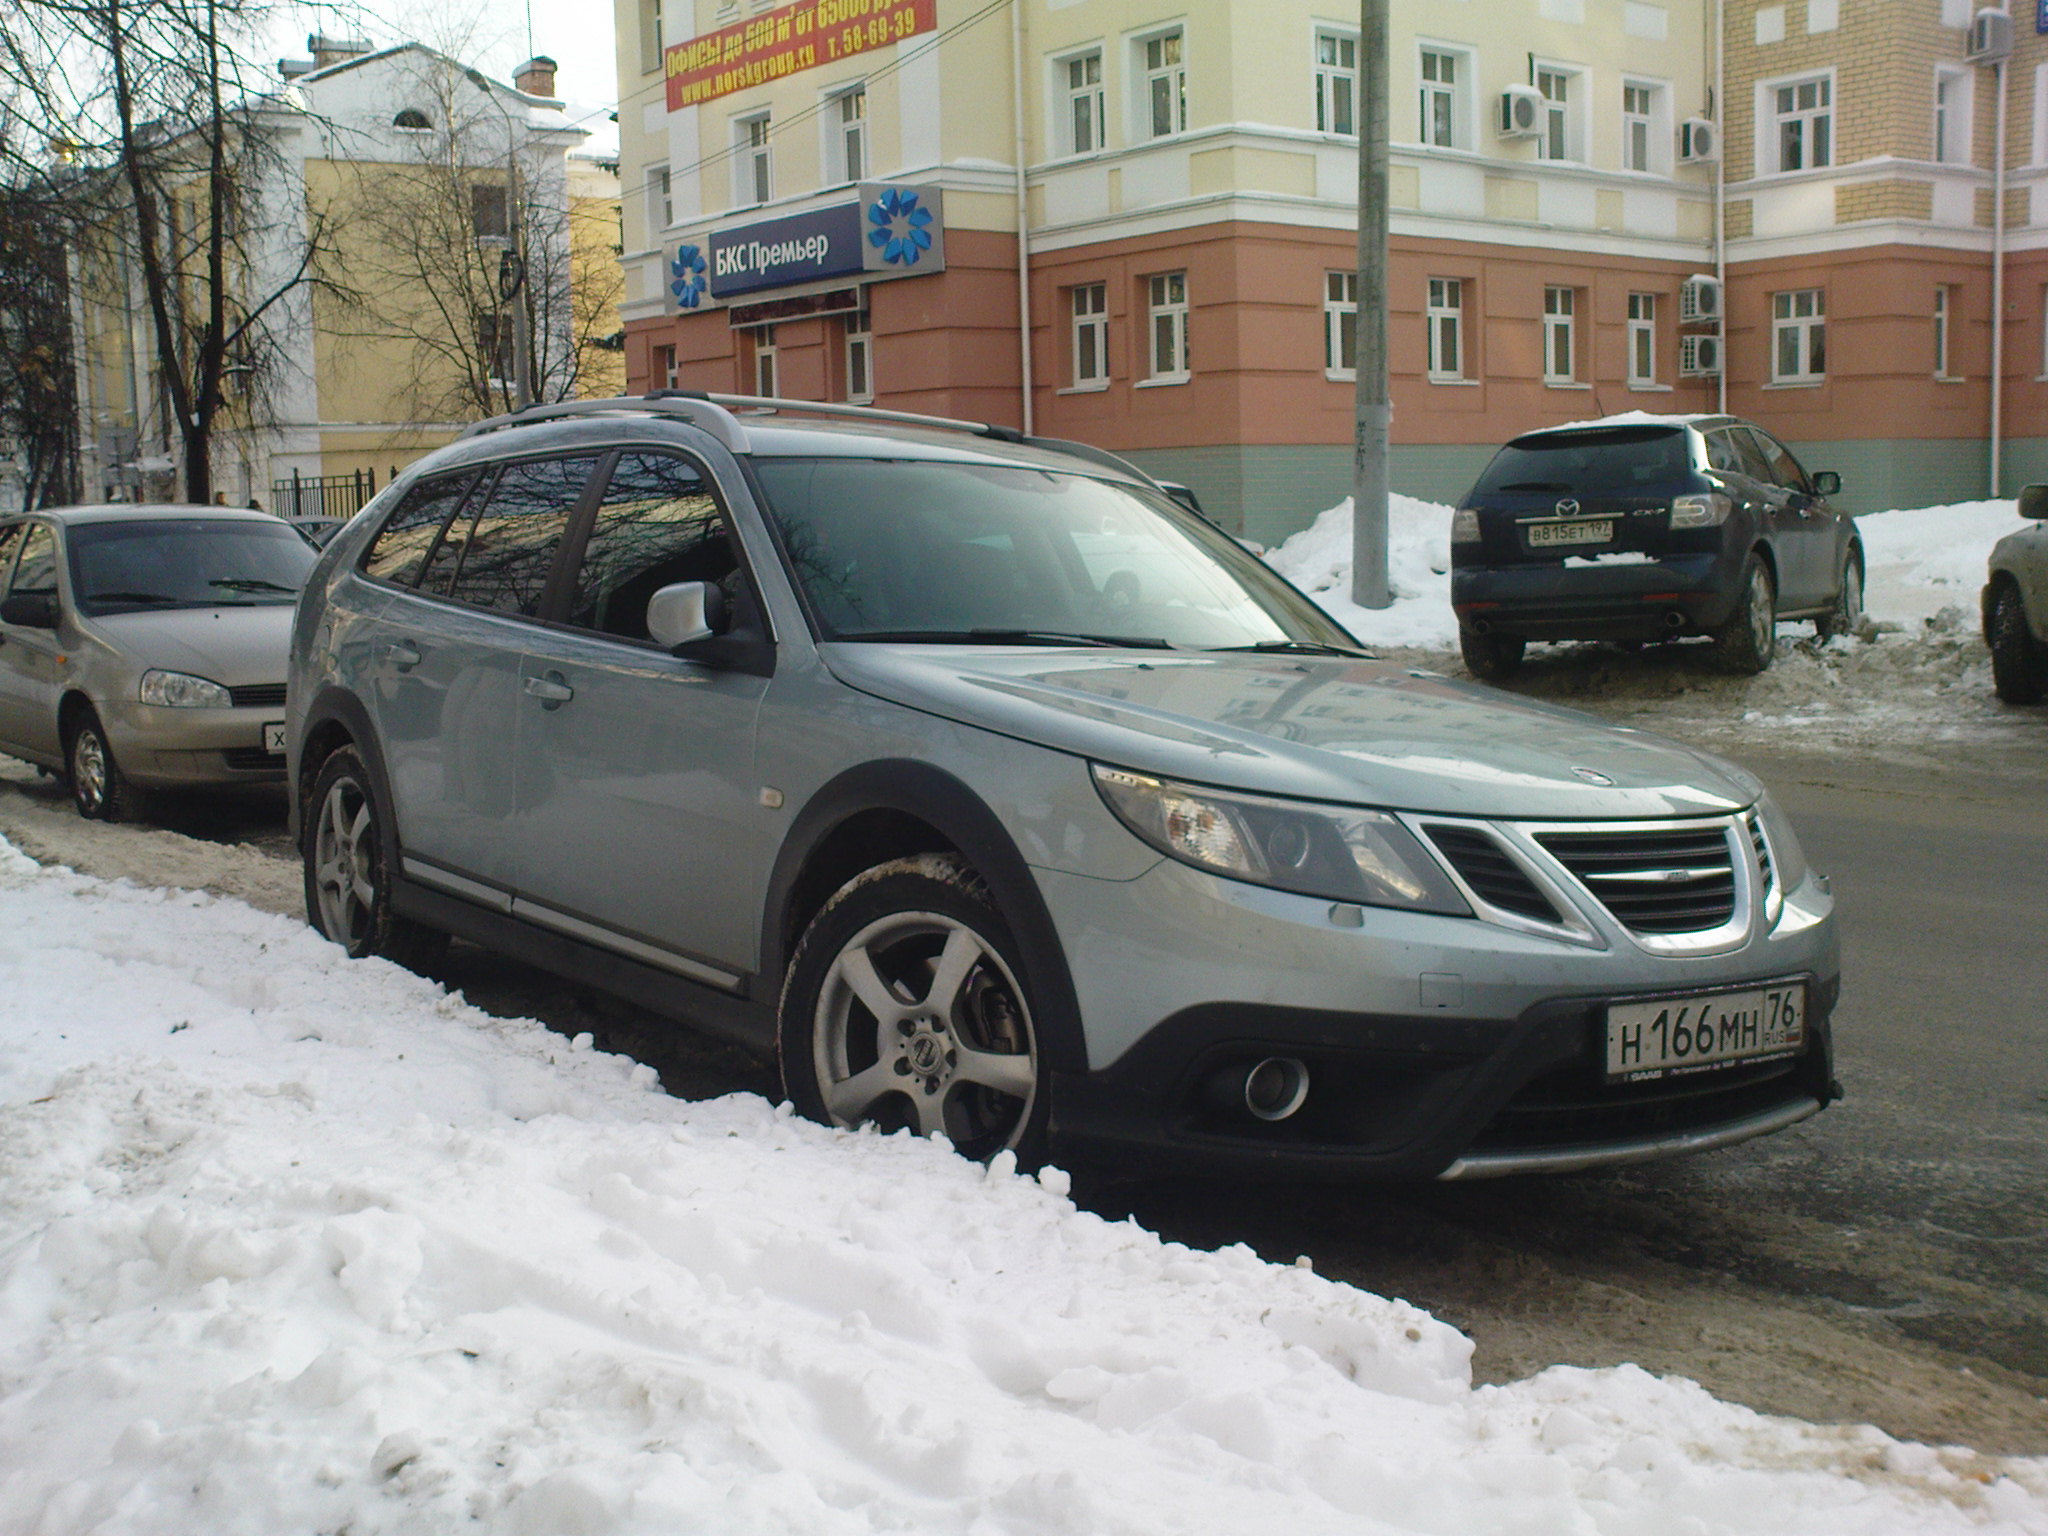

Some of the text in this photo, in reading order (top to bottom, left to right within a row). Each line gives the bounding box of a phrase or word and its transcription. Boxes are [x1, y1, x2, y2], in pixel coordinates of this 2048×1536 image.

[666, 35, 721, 78] ОФИСЫ
[723, 33, 744, 64] до
[745, 17, 774, 52] 500
[796, 8, 815, 36] от
[843, 7, 915, 53] 58-69-39
[682, 44, 815, 104] www.norskgroup.ru
[716, 234, 829, 276] БКС Премьер
[1768, 991, 1795, 1030] 76
[1764, 1030, 1785, 1046] RUS
